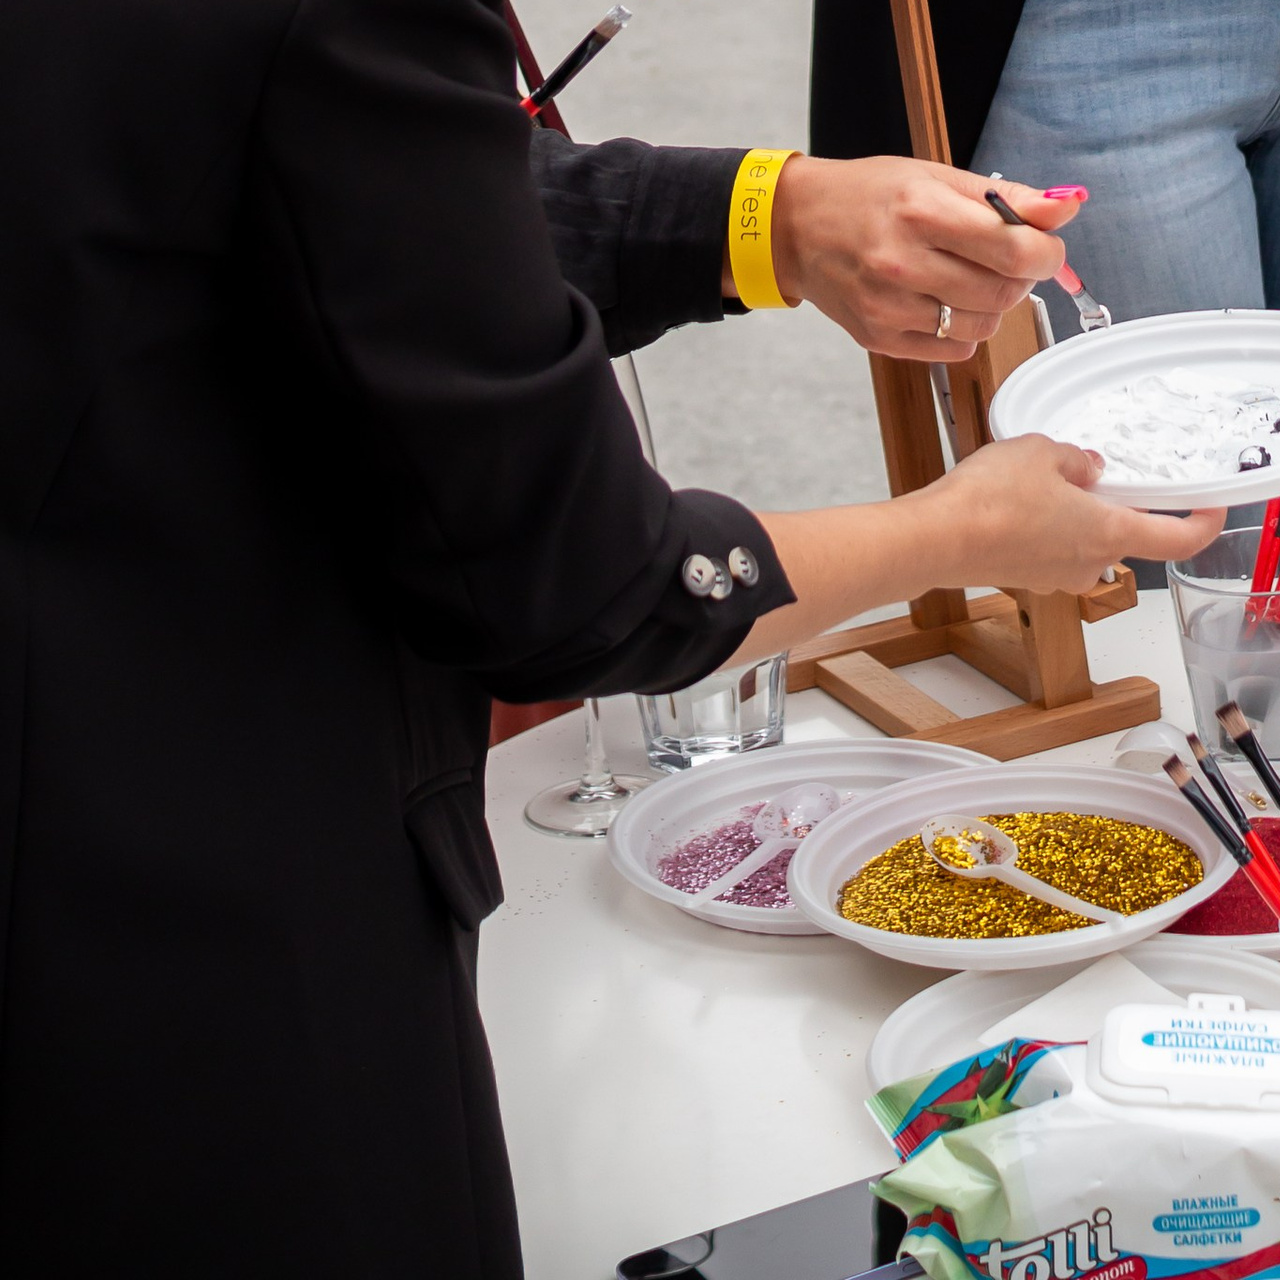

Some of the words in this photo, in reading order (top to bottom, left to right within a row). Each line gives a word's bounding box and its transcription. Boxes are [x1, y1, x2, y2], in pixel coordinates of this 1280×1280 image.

[741, 187, 767, 241] fest
[1172, 1194, 1239, 1211] ВЛАЖНЫЕ
[1161, 1210, 1251, 1229] ОЧИЩАЮЩИЕ
[1173, 1231, 1242, 1246] САЛФЕТКИ
